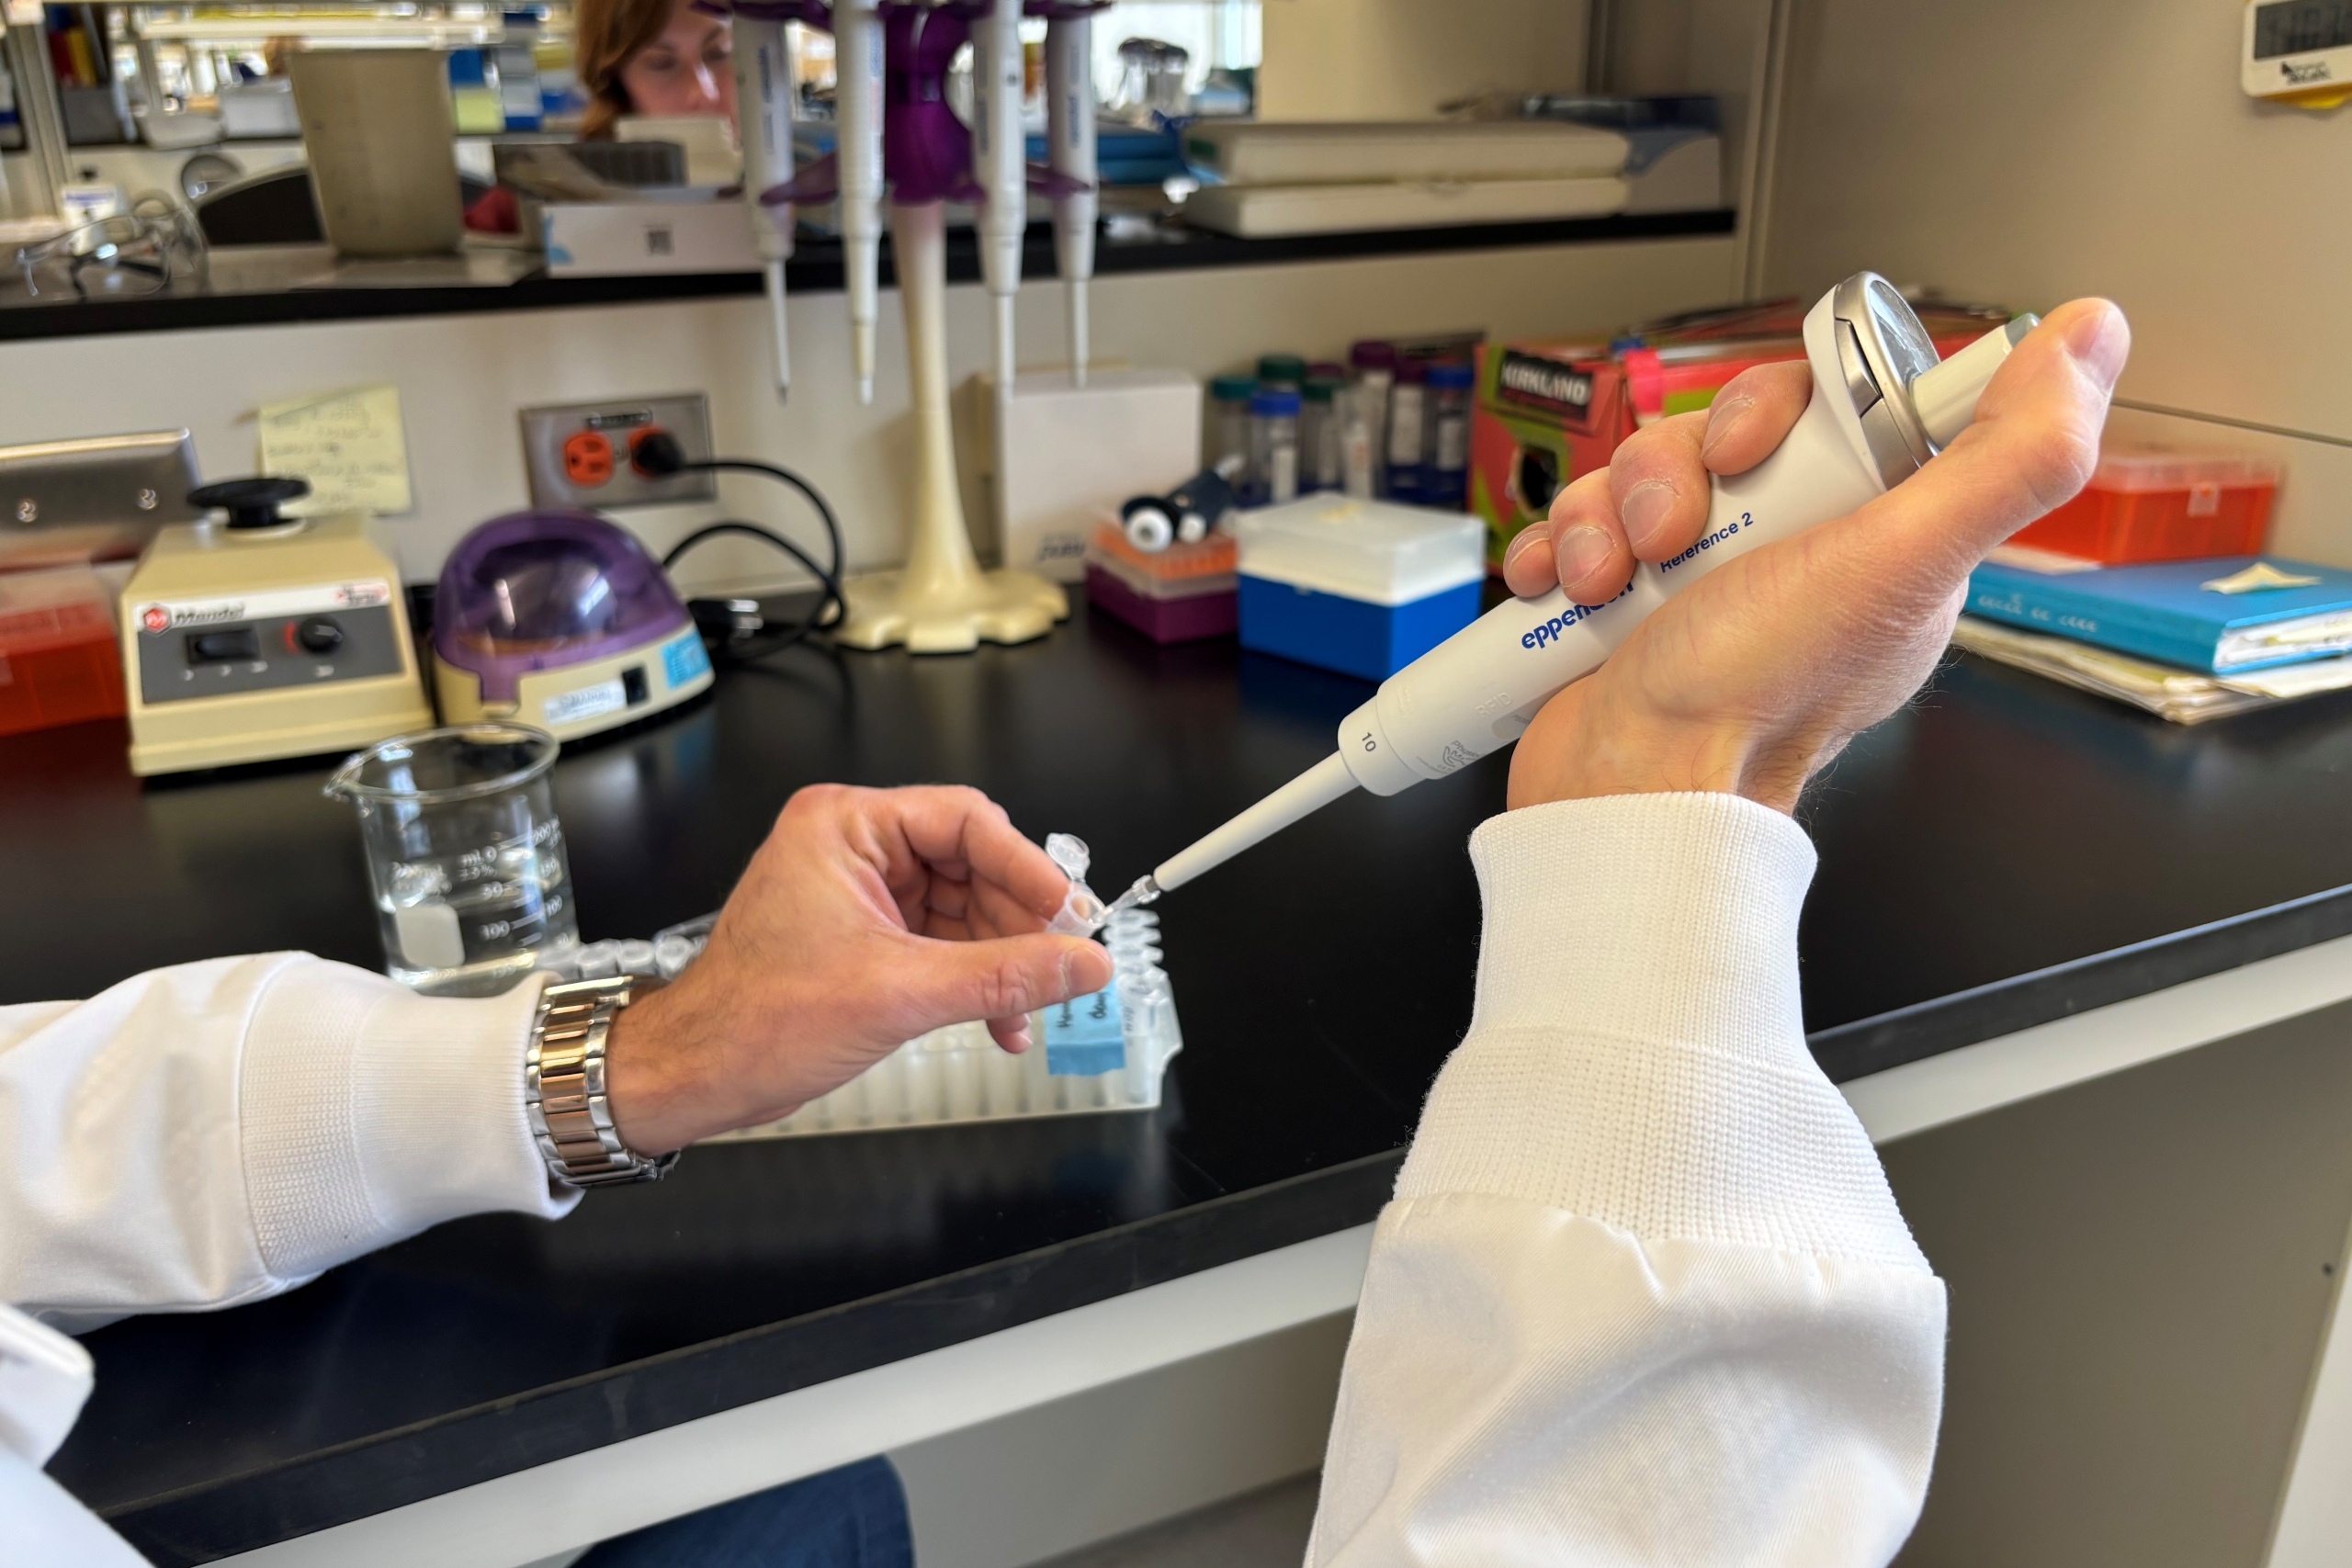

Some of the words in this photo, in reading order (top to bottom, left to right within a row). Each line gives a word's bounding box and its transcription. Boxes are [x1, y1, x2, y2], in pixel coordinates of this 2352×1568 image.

[1501, 361, 1589, 406] KIRKLAND
[1741, 512, 1754, 527] 2
[1521, 574, 1634, 649] eppen
[1475, 692, 1512, 718] RFID
[1361, 732, 1376, 752] 10
